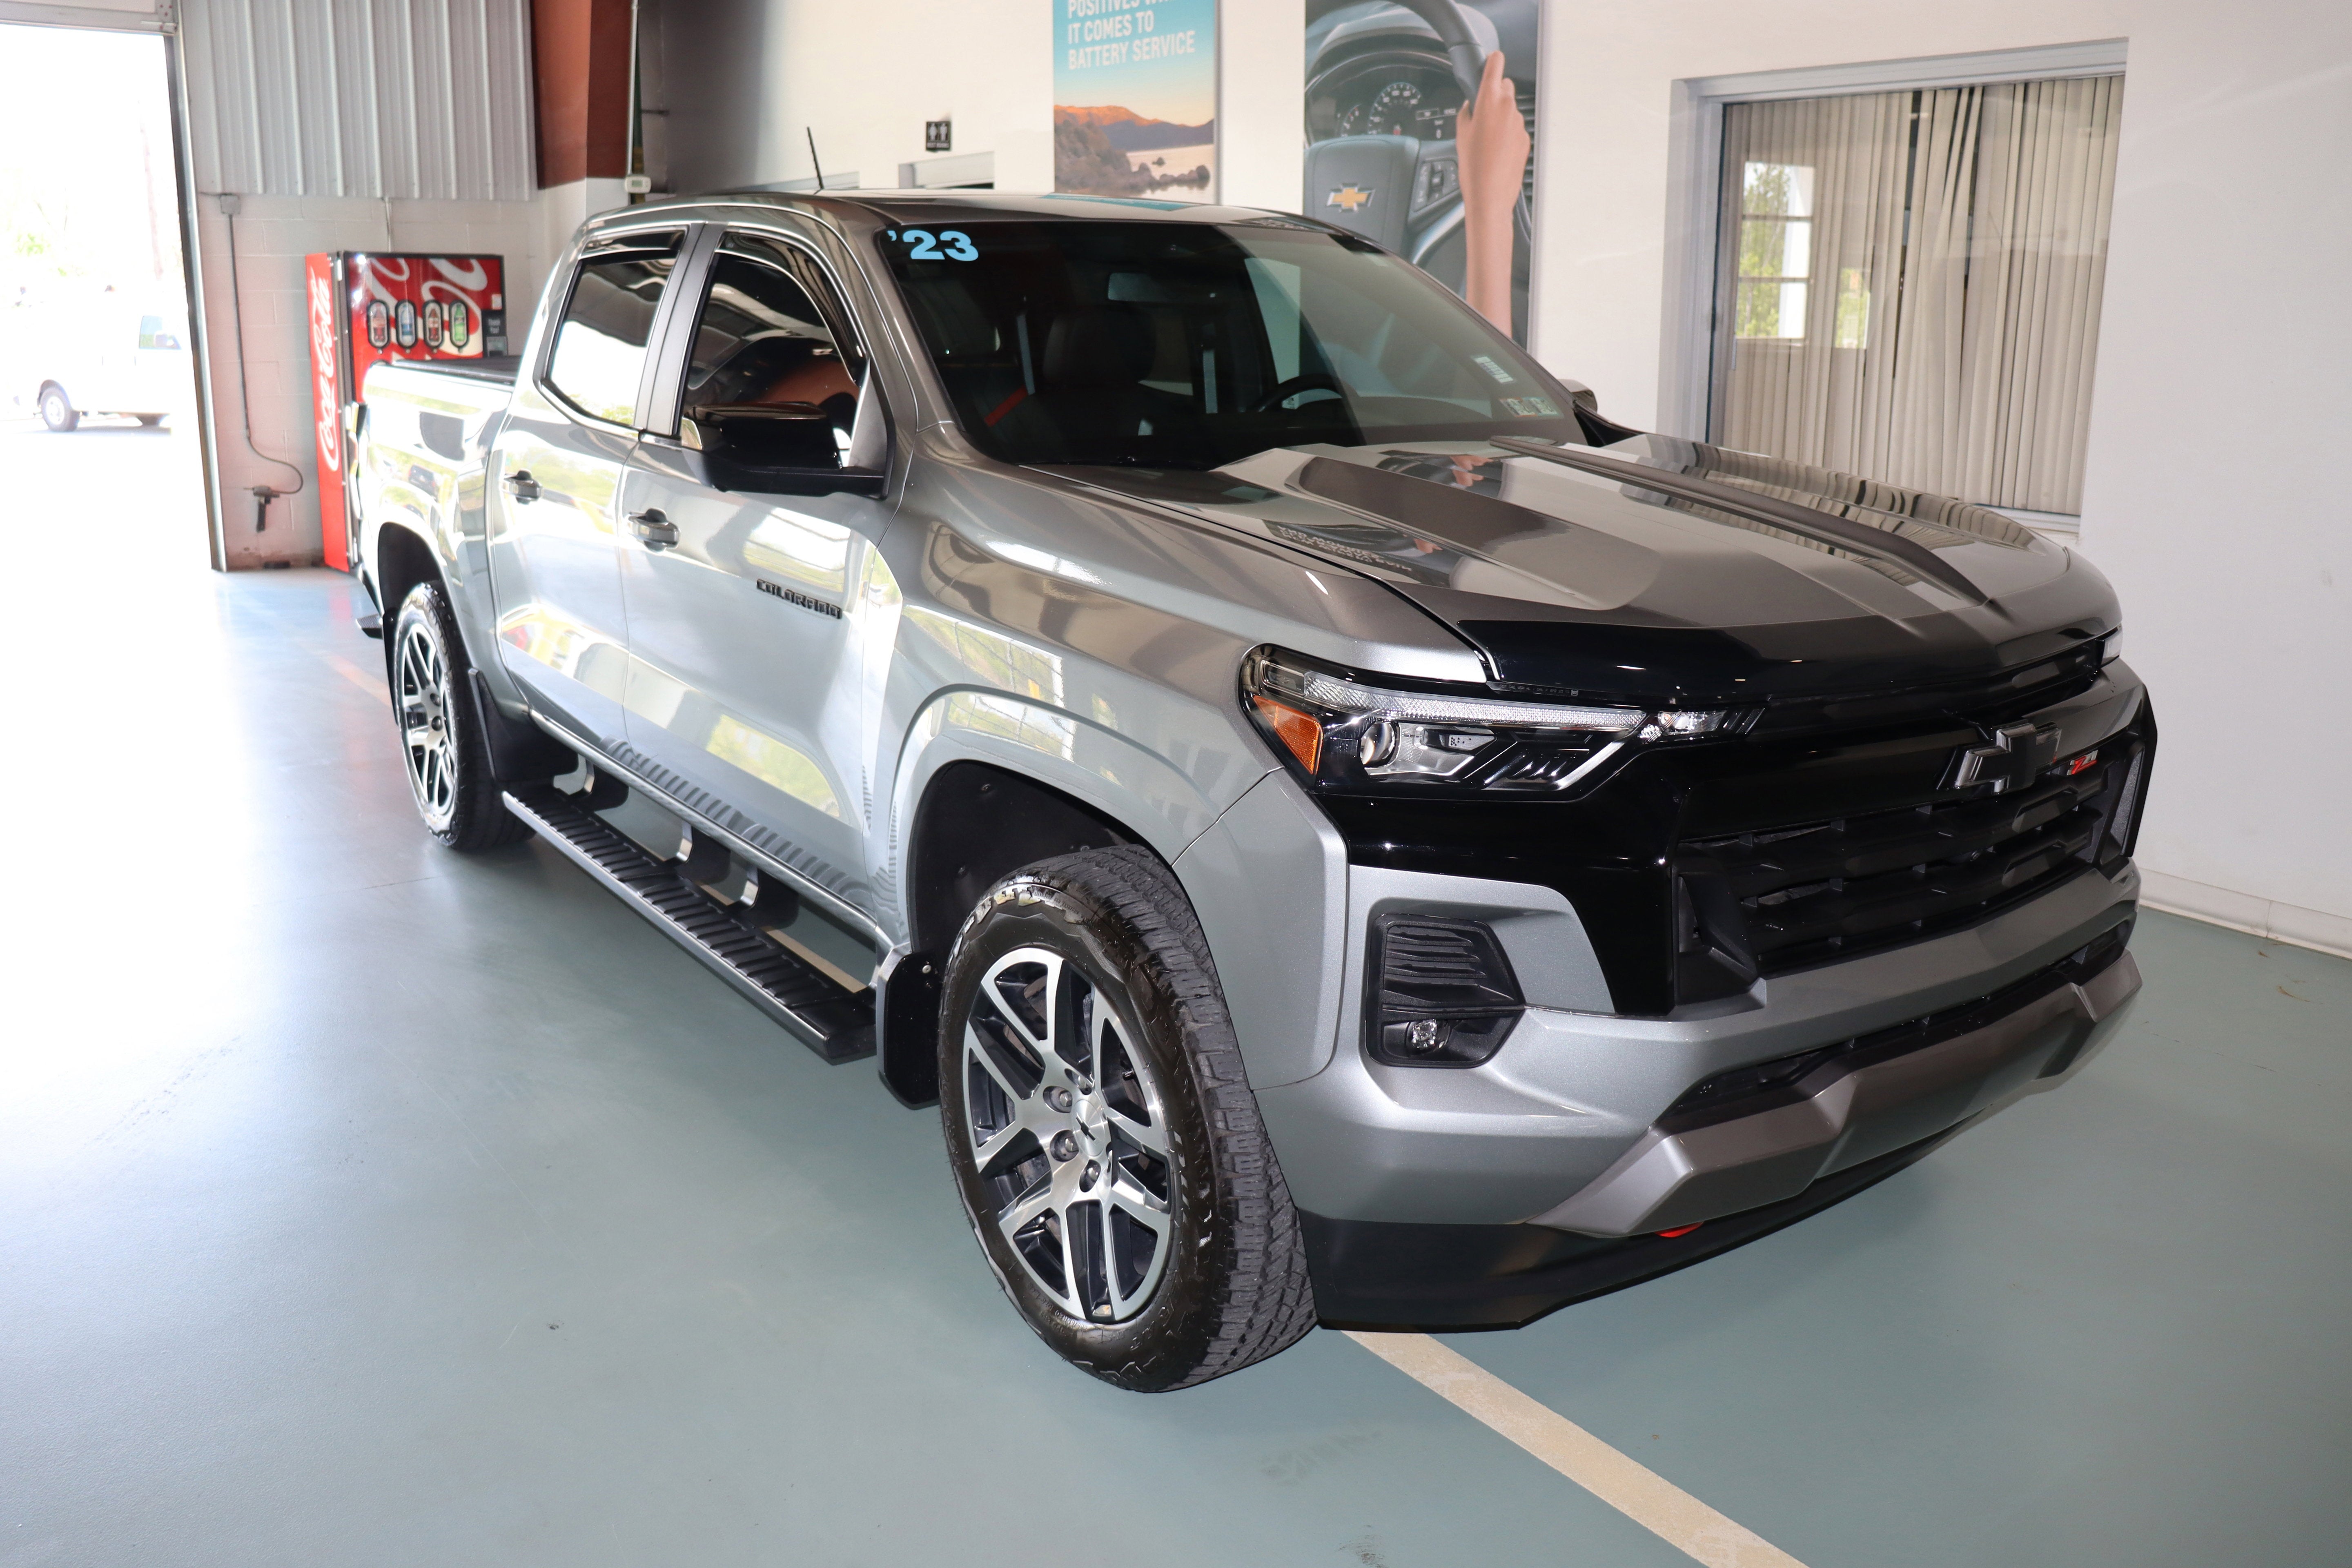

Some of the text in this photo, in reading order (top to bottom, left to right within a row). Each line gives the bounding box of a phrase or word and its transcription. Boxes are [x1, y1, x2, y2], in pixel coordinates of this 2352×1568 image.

[1068, 10, 1154, 44] IT COMES TO
[1068, 30, 1196, 70] BATTERY SERVICE
[310, 265, 339, 472] Coca-Cola
[757, 578, 842, 619] COLORADO
